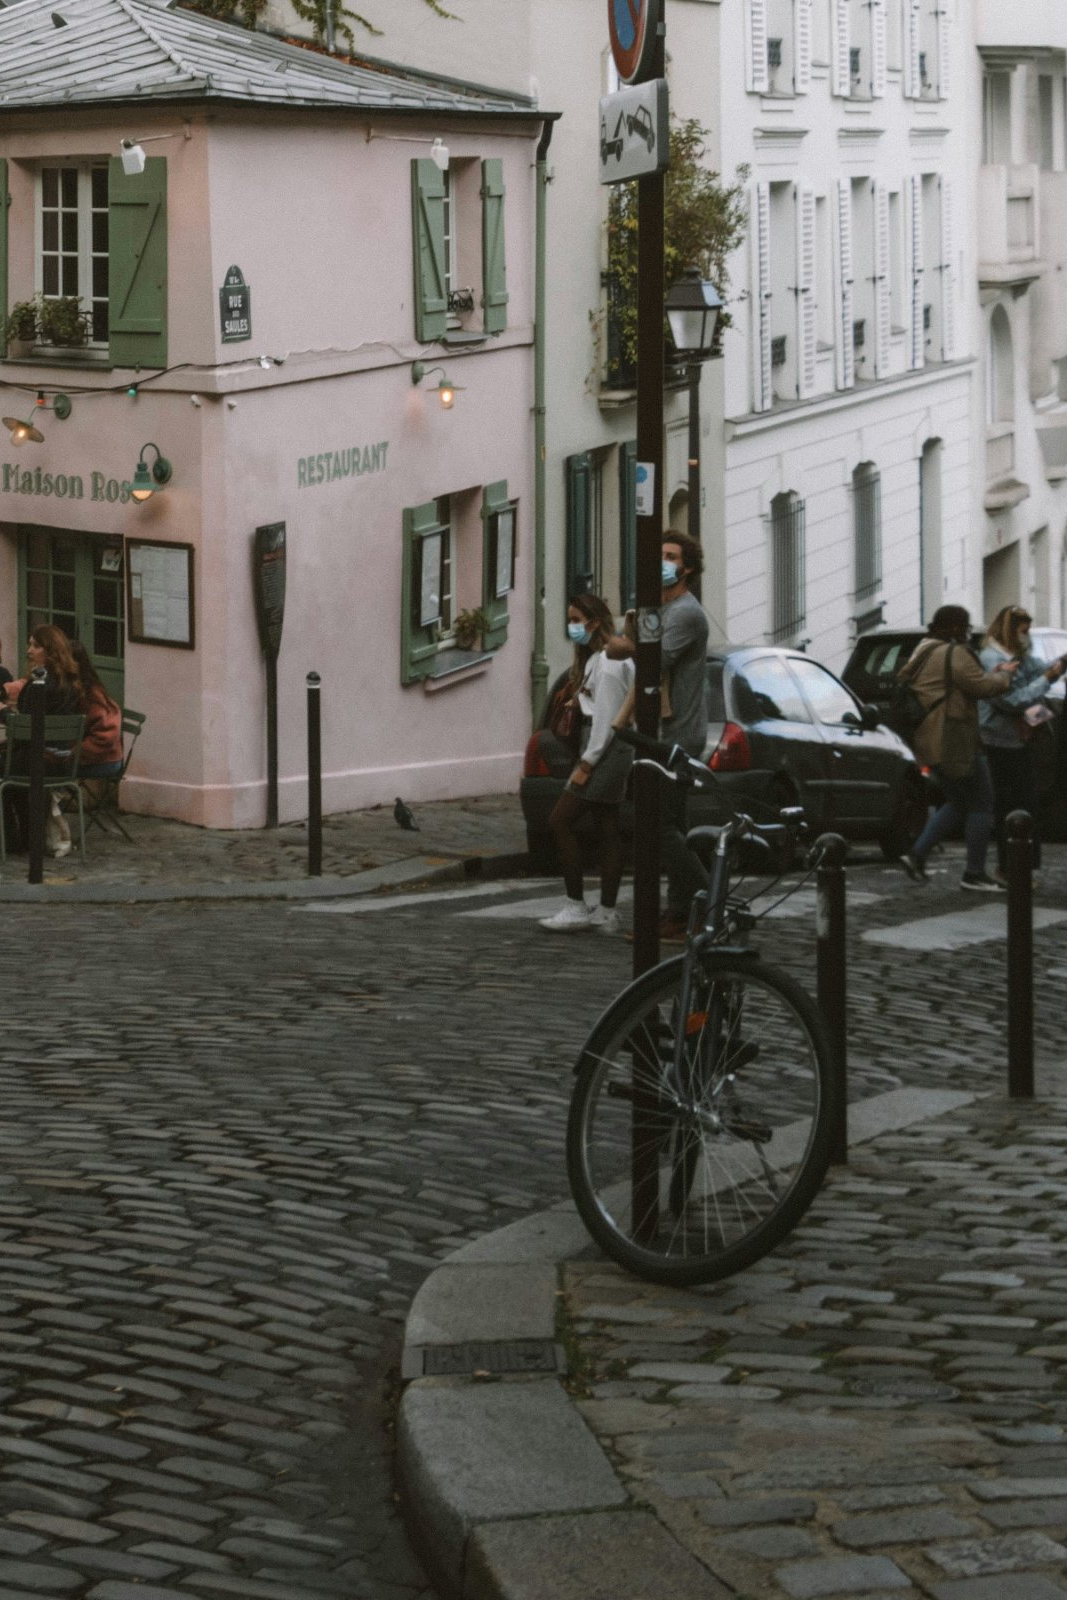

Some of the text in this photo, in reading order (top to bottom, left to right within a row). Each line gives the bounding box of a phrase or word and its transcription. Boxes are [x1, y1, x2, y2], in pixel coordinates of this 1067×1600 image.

[228, 295, 242, 308] RUE
[225, 319, 248, 333] SAULES
[297, 441, 389, 489] RESTAURANT
[2, 463, 83, 499] Maison
[90, 471, 142, 505] Ros
